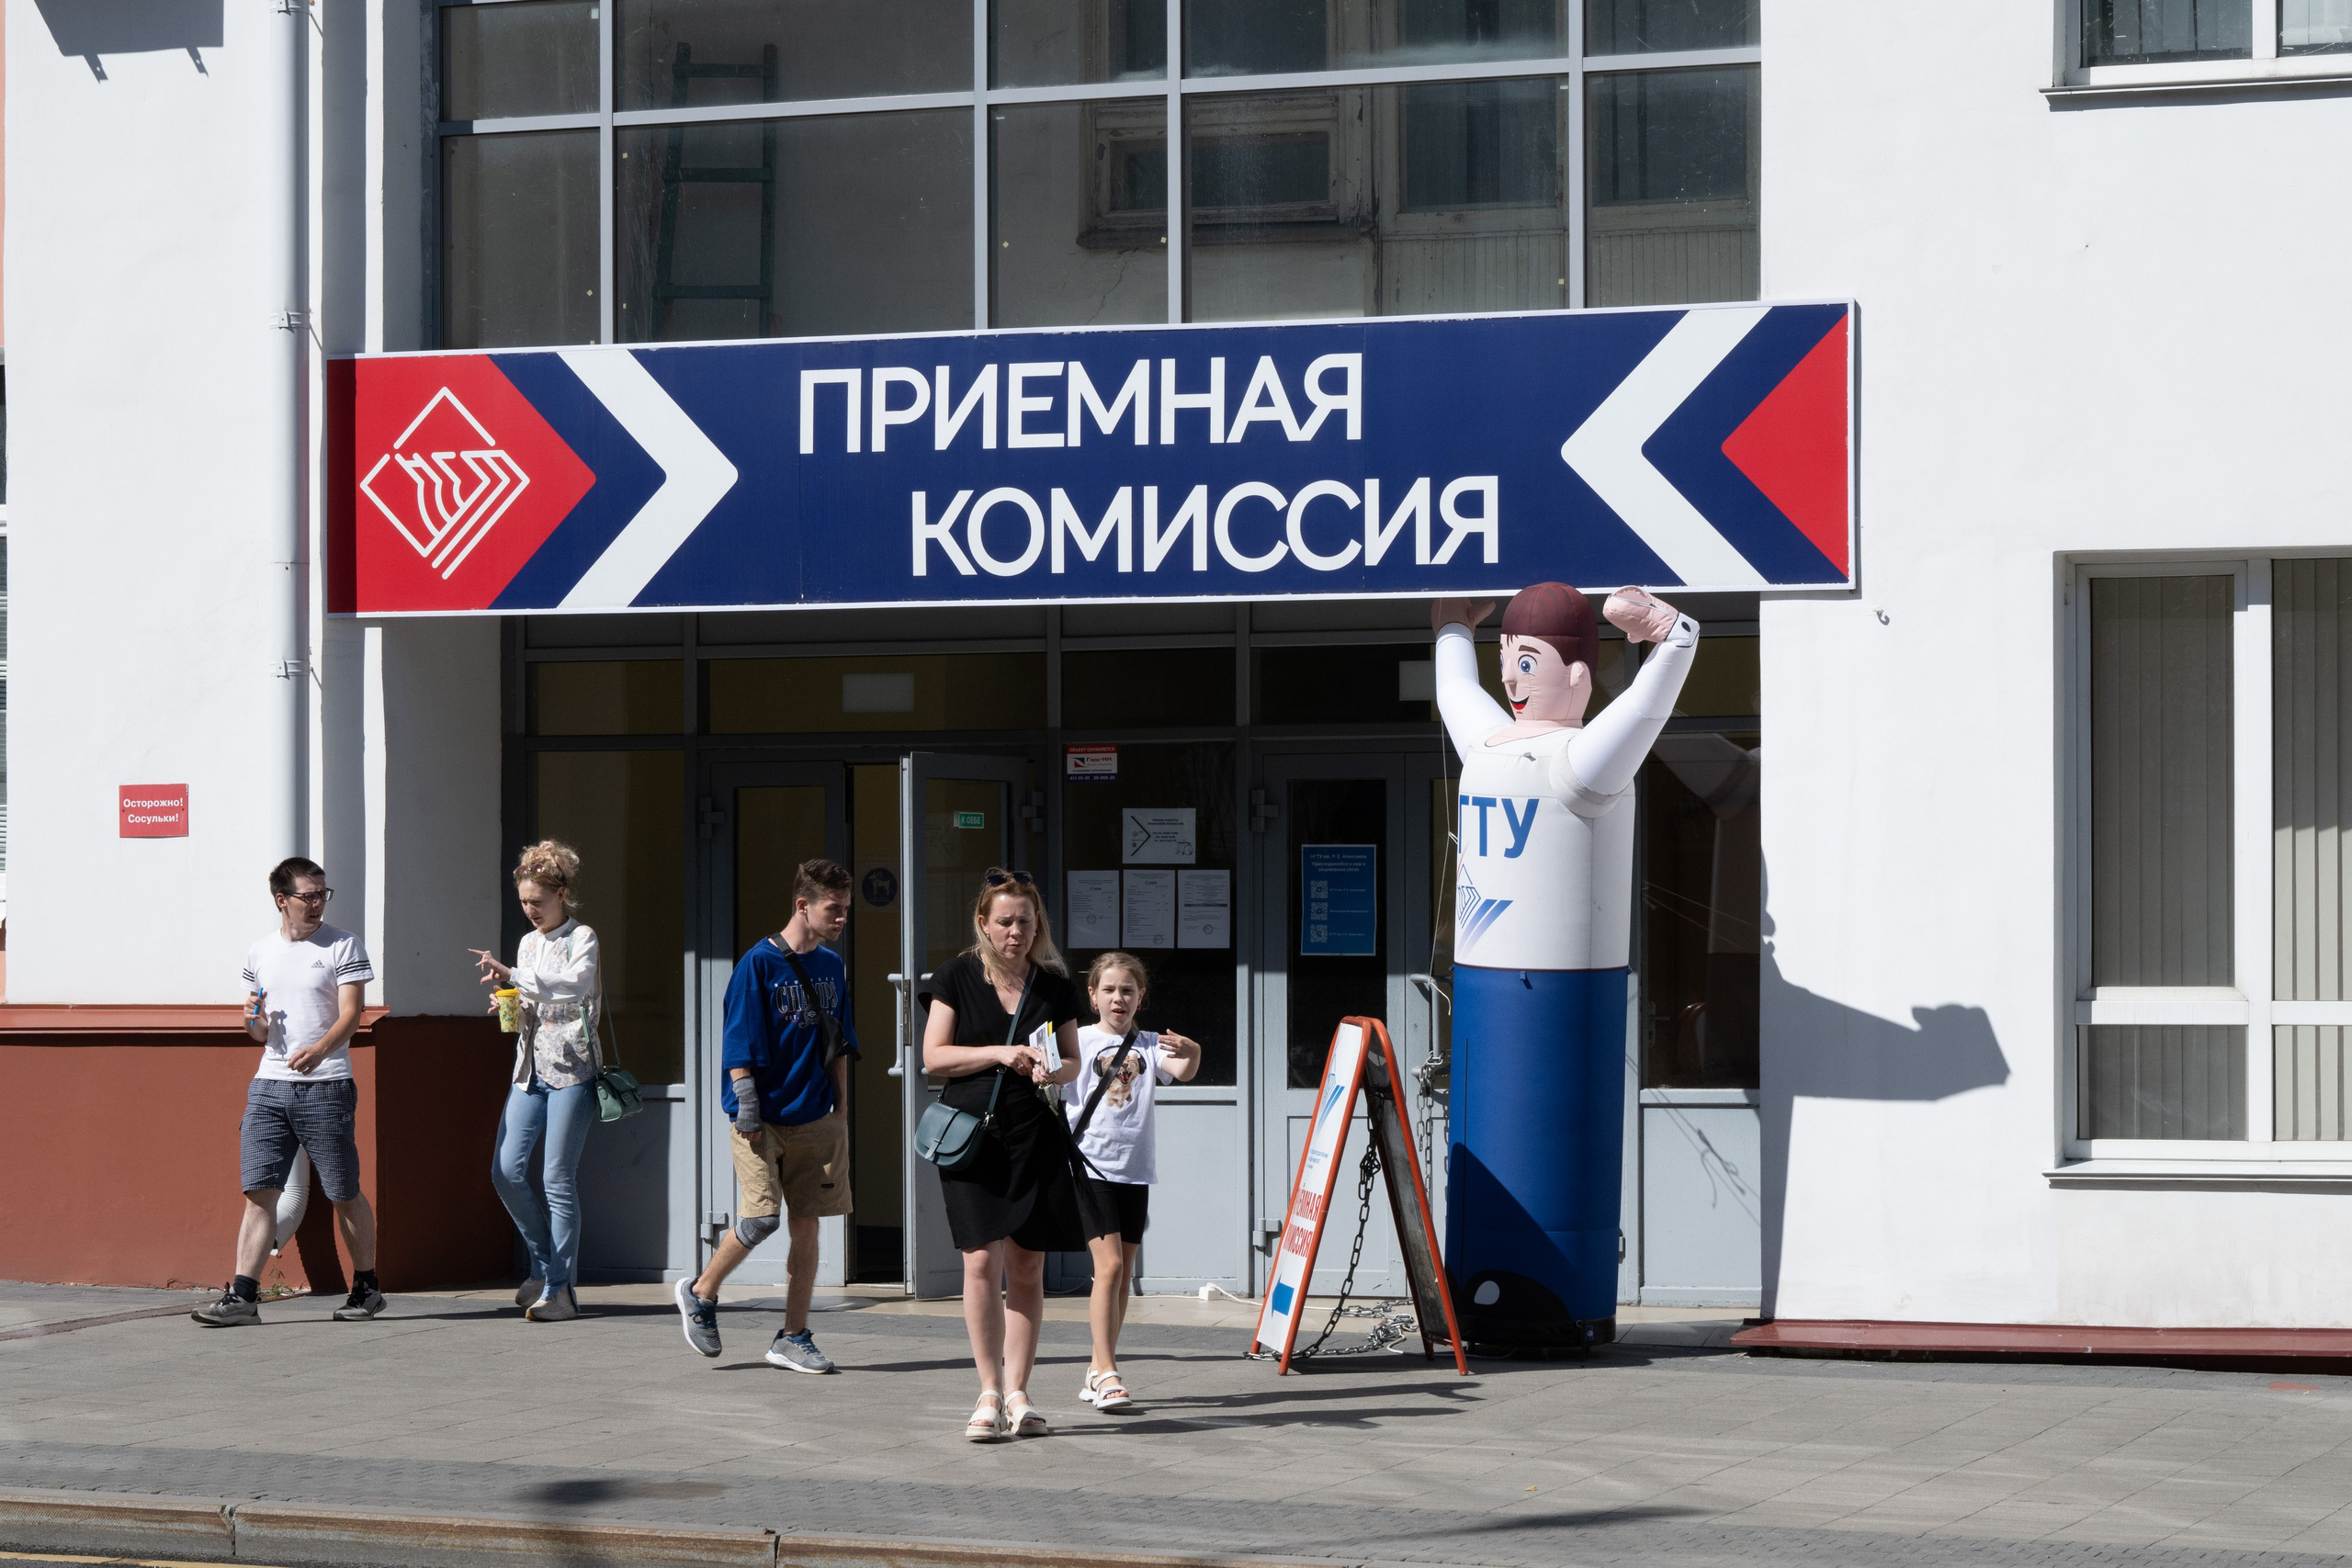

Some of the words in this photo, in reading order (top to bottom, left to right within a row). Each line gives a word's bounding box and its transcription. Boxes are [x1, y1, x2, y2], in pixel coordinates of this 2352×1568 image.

[799, 353, 1363, 454] ПРИЕМНАЯ
[911, 476, 1498, 577] КОМИССИЯ
[123, 797, 184, 809] Осторожно!
[128, 813, 179, 825] Сосульки!
[961, 816, 966, 824] К
[966, 816, 981, 824] СЕБЕ
